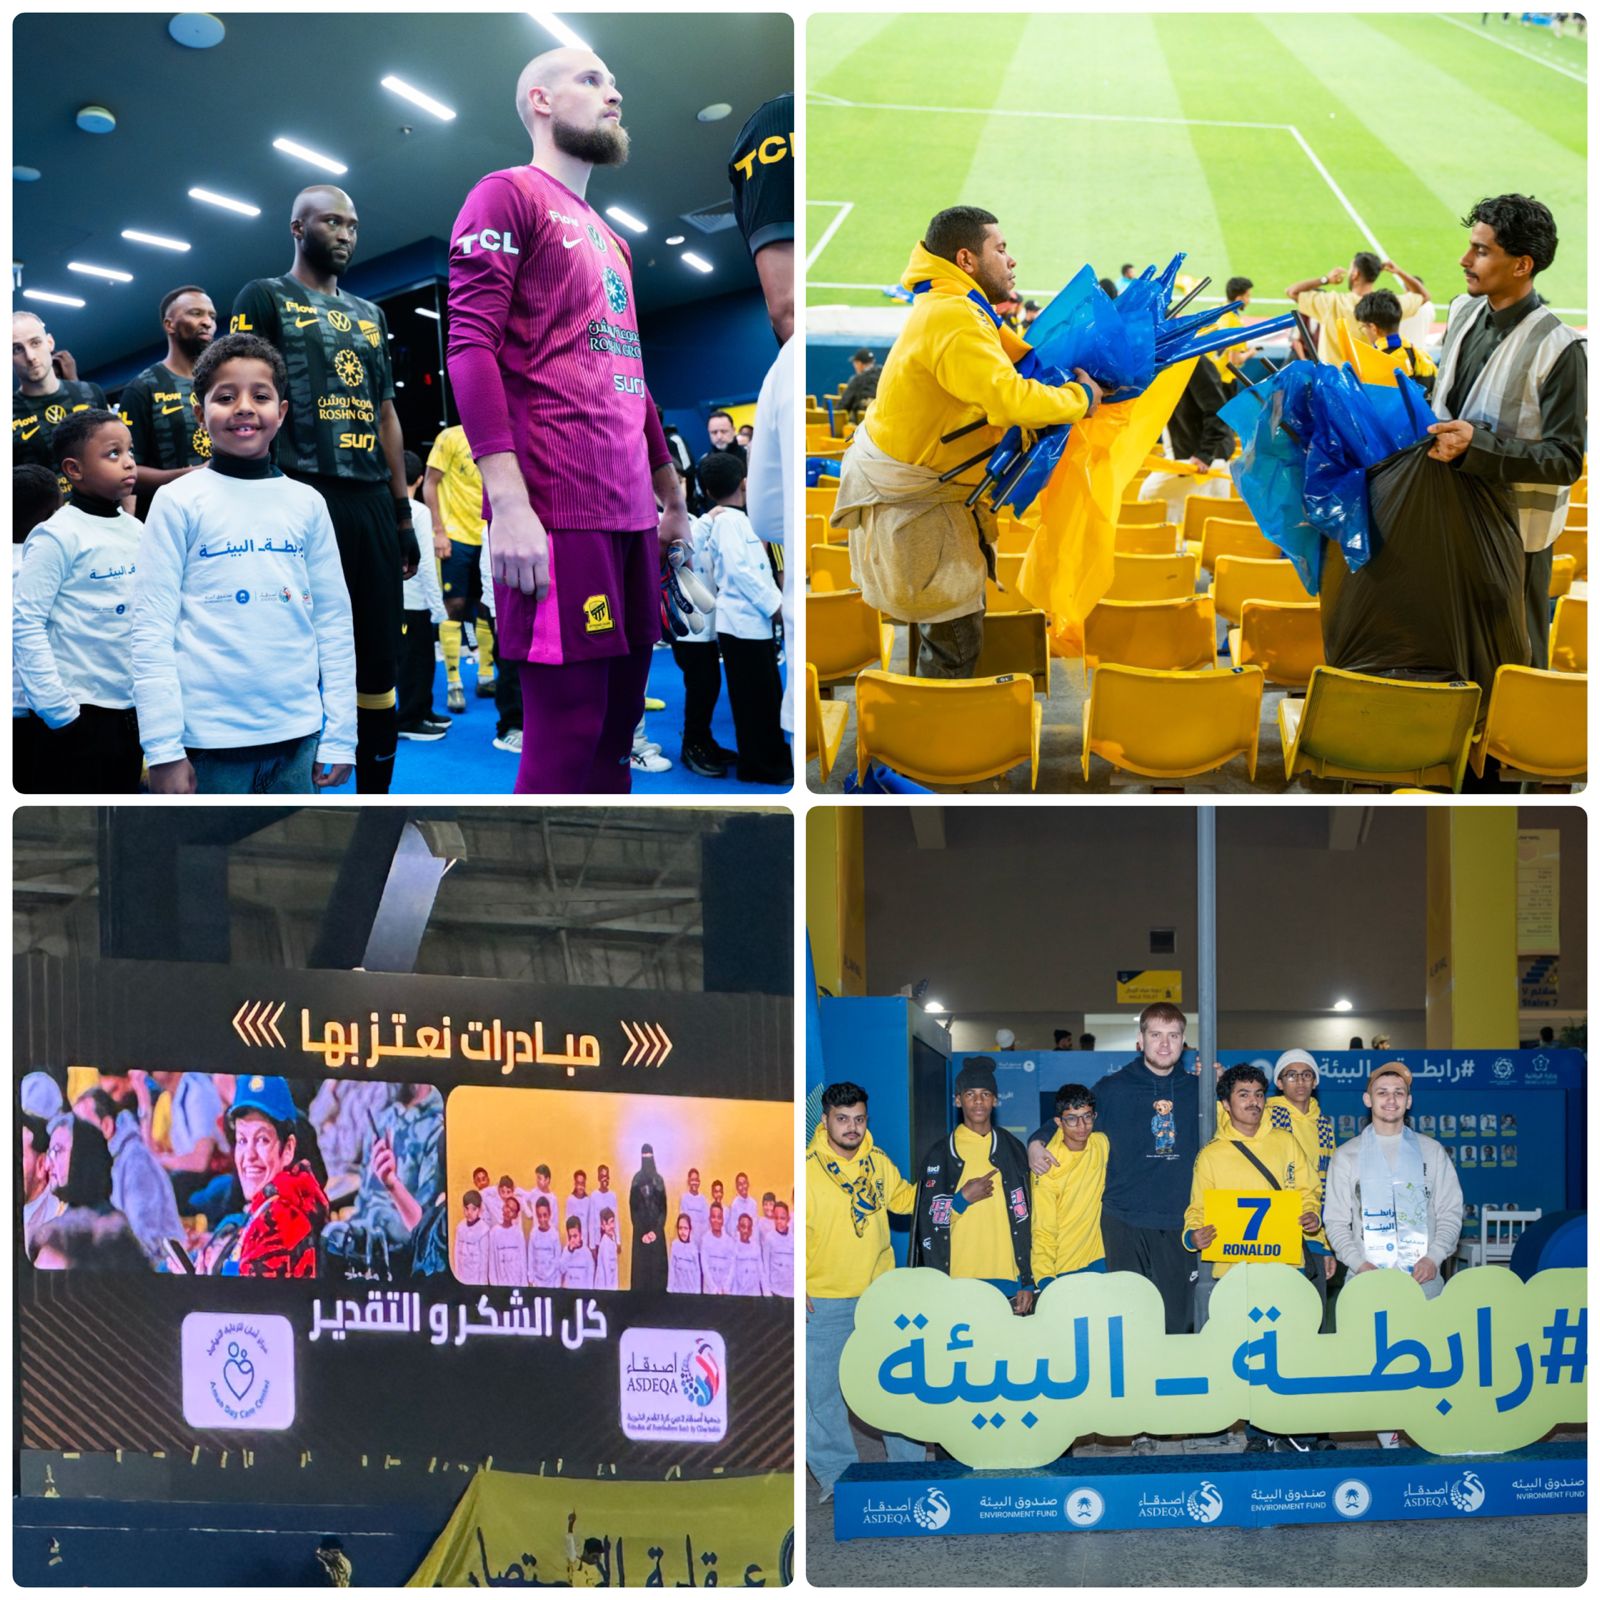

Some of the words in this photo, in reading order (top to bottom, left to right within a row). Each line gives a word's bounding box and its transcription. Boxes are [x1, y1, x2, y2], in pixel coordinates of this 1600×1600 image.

[734, 133, 795, 181] TC
[456, 229, 519, 255] TCL
[286, 301, 318, 315] Flow
[230, 313, 253, 335] CL
[622, 343, 641, 358] GRO
[613, 374, 645, 399] surj
[154, 392, 182, 403] Flow
[13, 415, 38, 430] Flow
[319, 409, 356, 421] ROSHN
[357, 410, 374, 423] GRO
[339, 433, 376, 452] surj
[301, 1008, 359, 1068] بها
[366, 1012, 451, 1068] نعتز
[460, 1018, 601, 1076] مبادرات
[1237, 1197, 1271, 1241] 7
[1223, 1243, 1281, 1256] RONALDO
[309, 1290, 421, 1342] التقدير
[454, 1289, 552, 1346] الشكر
[429, 1303, 449, 1346] و
[561, 1298, 607, 1350] كل
[626, 1376, 678, 1395] ASDEQA
[1544, 1478, 1585, 1490] صندوق
[1251, 1488, 1282, 1502] البيئة
[1285, 1489, 1327, 1502] صندوق
[1565, 1490, 1585, 1498] FUND
[979, 1496, 1012, 1509] البيئة
[1014, 1496, 1058, 1509] صندوق
[1251, 1502, 1304, 1512] ENVIRONMENT
[1305, 1501, 1327, 1509] FUND
[1403, 1497, 1449, 1508] ASDEQA
[863, 1513, 912, 1525] ASDEQA
[979, 1510, 1035, 1519] ENVIRONMENT
[1036, 1509, 1058, 1518] FUND
[1138, 1506, 1185, 1518] ASDEQA
